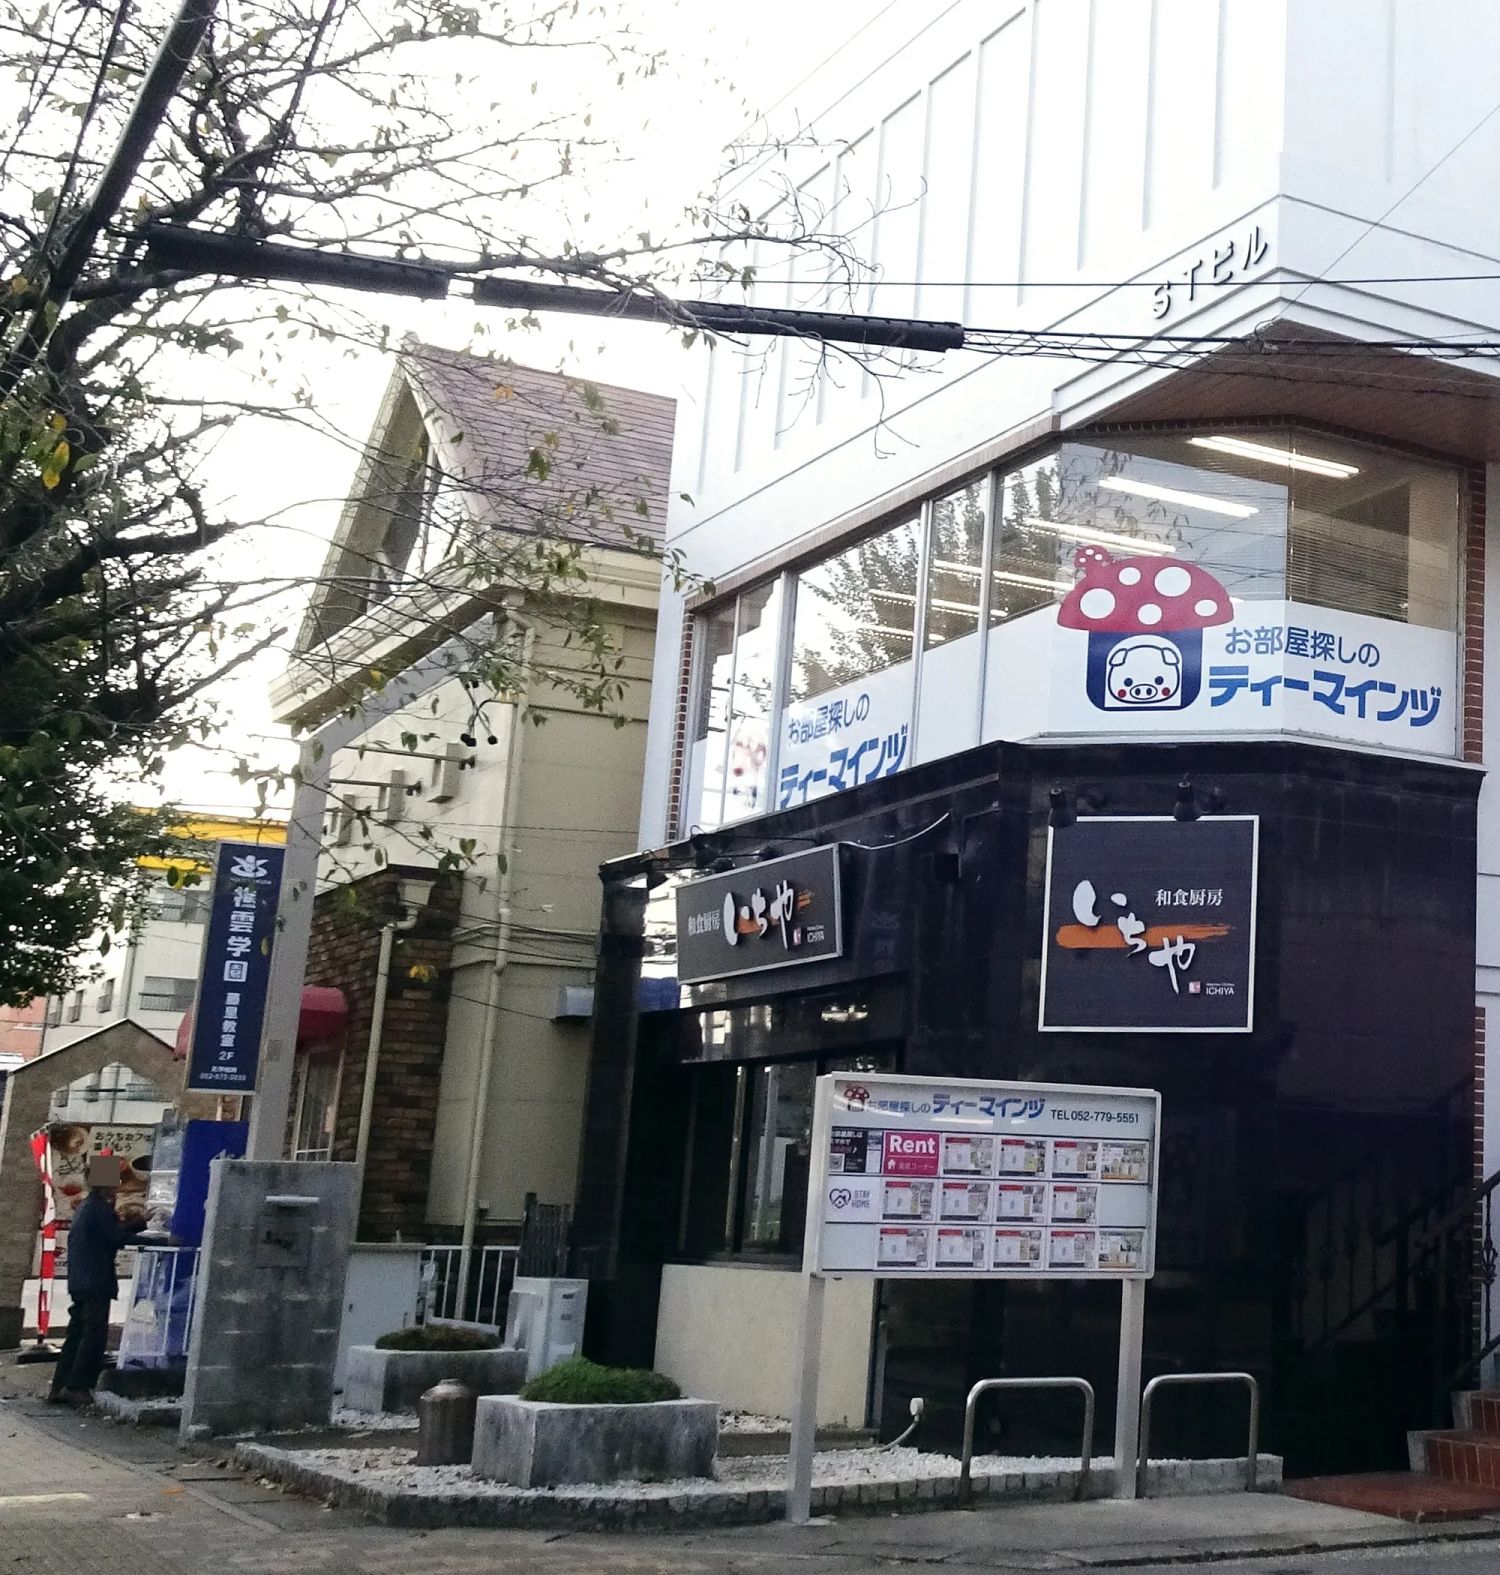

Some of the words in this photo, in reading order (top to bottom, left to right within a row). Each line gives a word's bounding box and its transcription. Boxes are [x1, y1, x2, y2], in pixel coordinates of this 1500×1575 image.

[1225, 626, 1380, 667] お部屋探しの
[788, 693, 870, 745] お部屋探しの
[1155, 888, 1224, 906] 和食厨房
[723, 879, 795, 950] いちや
[1072, 879, 1196, 995] いちや
[1206, 987, 1234, 995] ICHIYA
[219, 1051, 235, 1061] 2F
[889, 1135, 936, 1154] Rent
[853, 1190, 870, 1199] STAY
[851, 1201, 870, 1209] HOME
